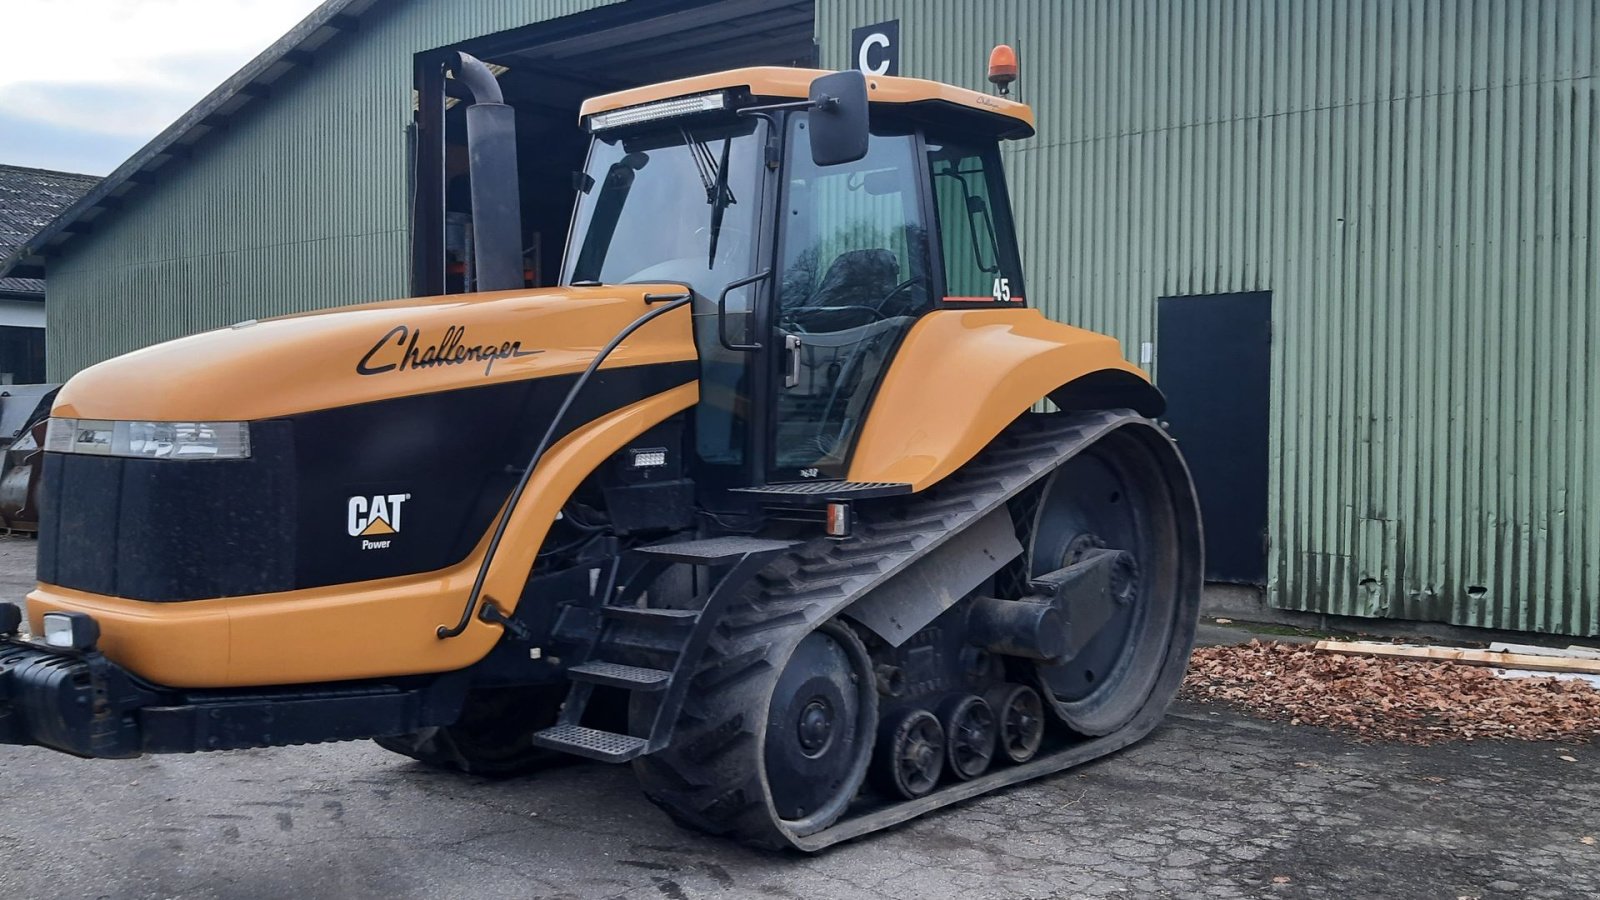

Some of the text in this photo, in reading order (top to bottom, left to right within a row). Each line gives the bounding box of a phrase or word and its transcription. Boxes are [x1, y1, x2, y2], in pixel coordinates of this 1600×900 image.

[859, 33, 890, 76] C
[993, 278, 1010, 302] 45
[356, 325, 546, 376] Challenger
[362, 540, 391, 550] Power
